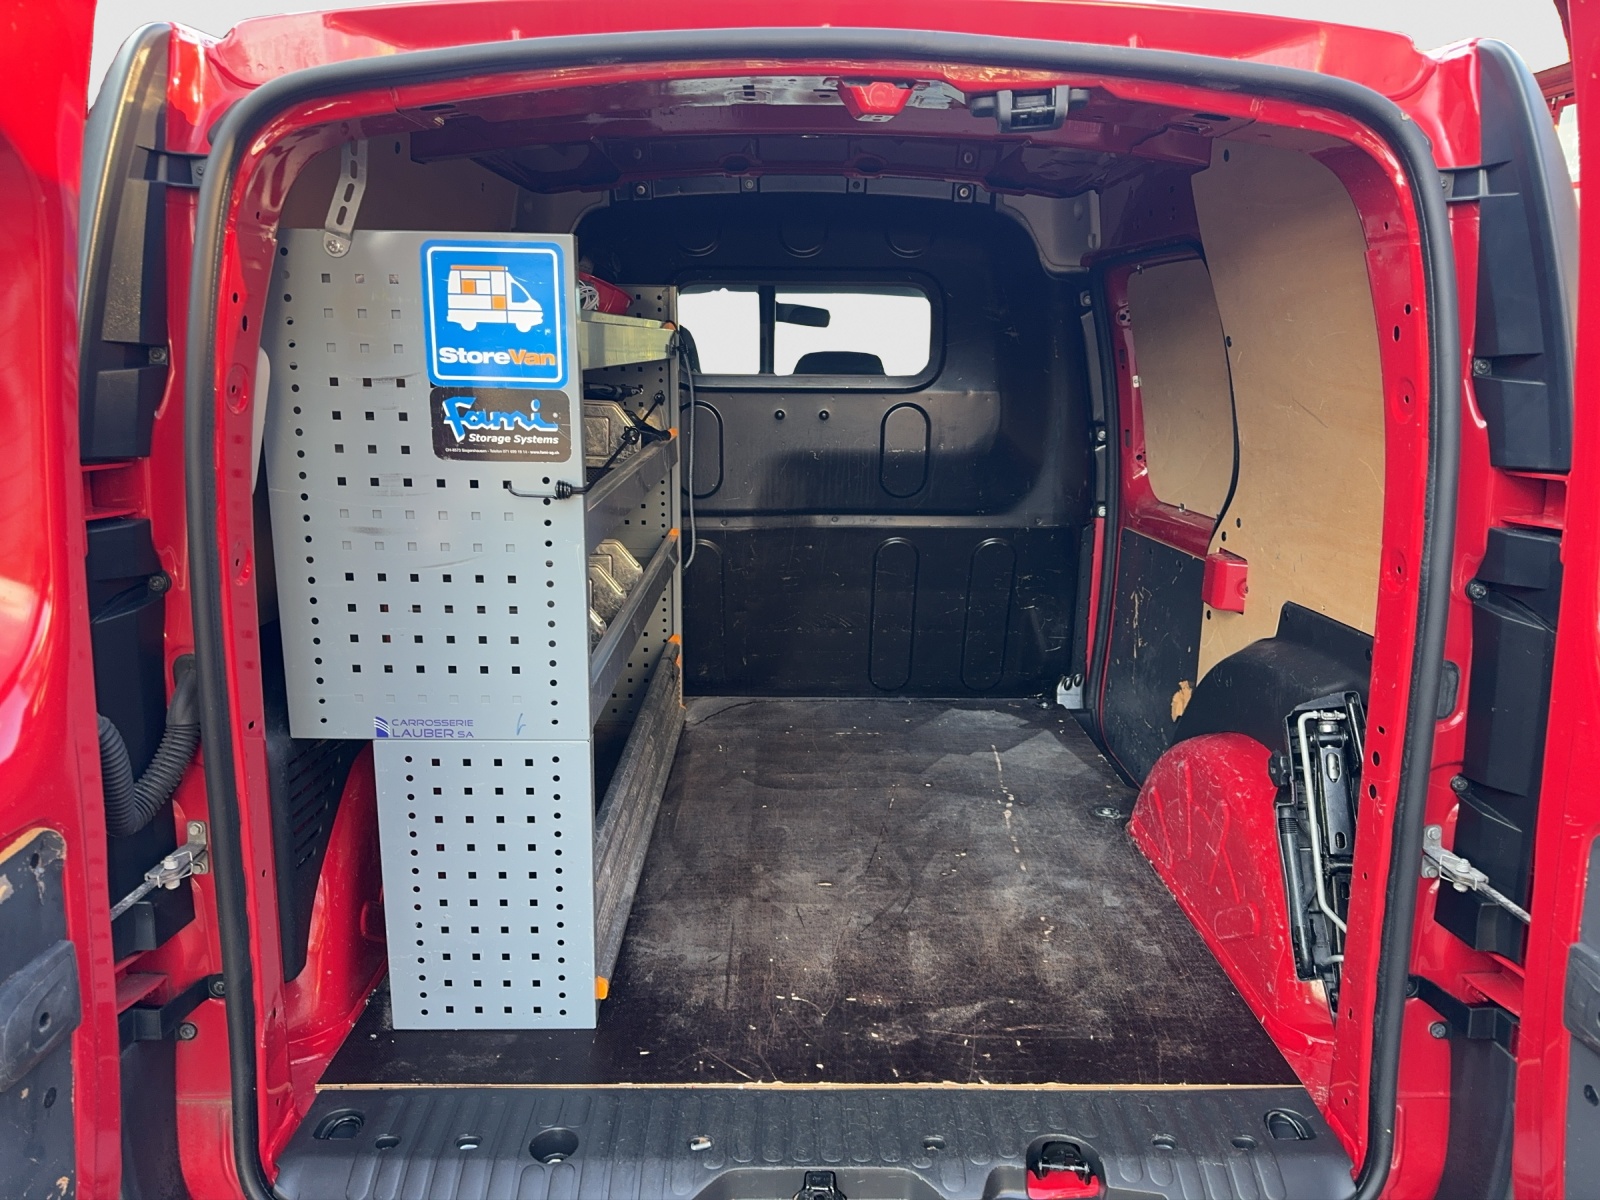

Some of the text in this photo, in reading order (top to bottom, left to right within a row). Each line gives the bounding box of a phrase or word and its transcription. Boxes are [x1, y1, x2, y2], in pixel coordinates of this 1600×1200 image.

[439, 346, 556, 366] StoreVan
[442, 396, 559, 443] Fami
[468, 433, 559, 446] Storage Systems
[391, 718, 474, 727] CARROSSERIE
[392, 728, 454, 738] LAUBER
